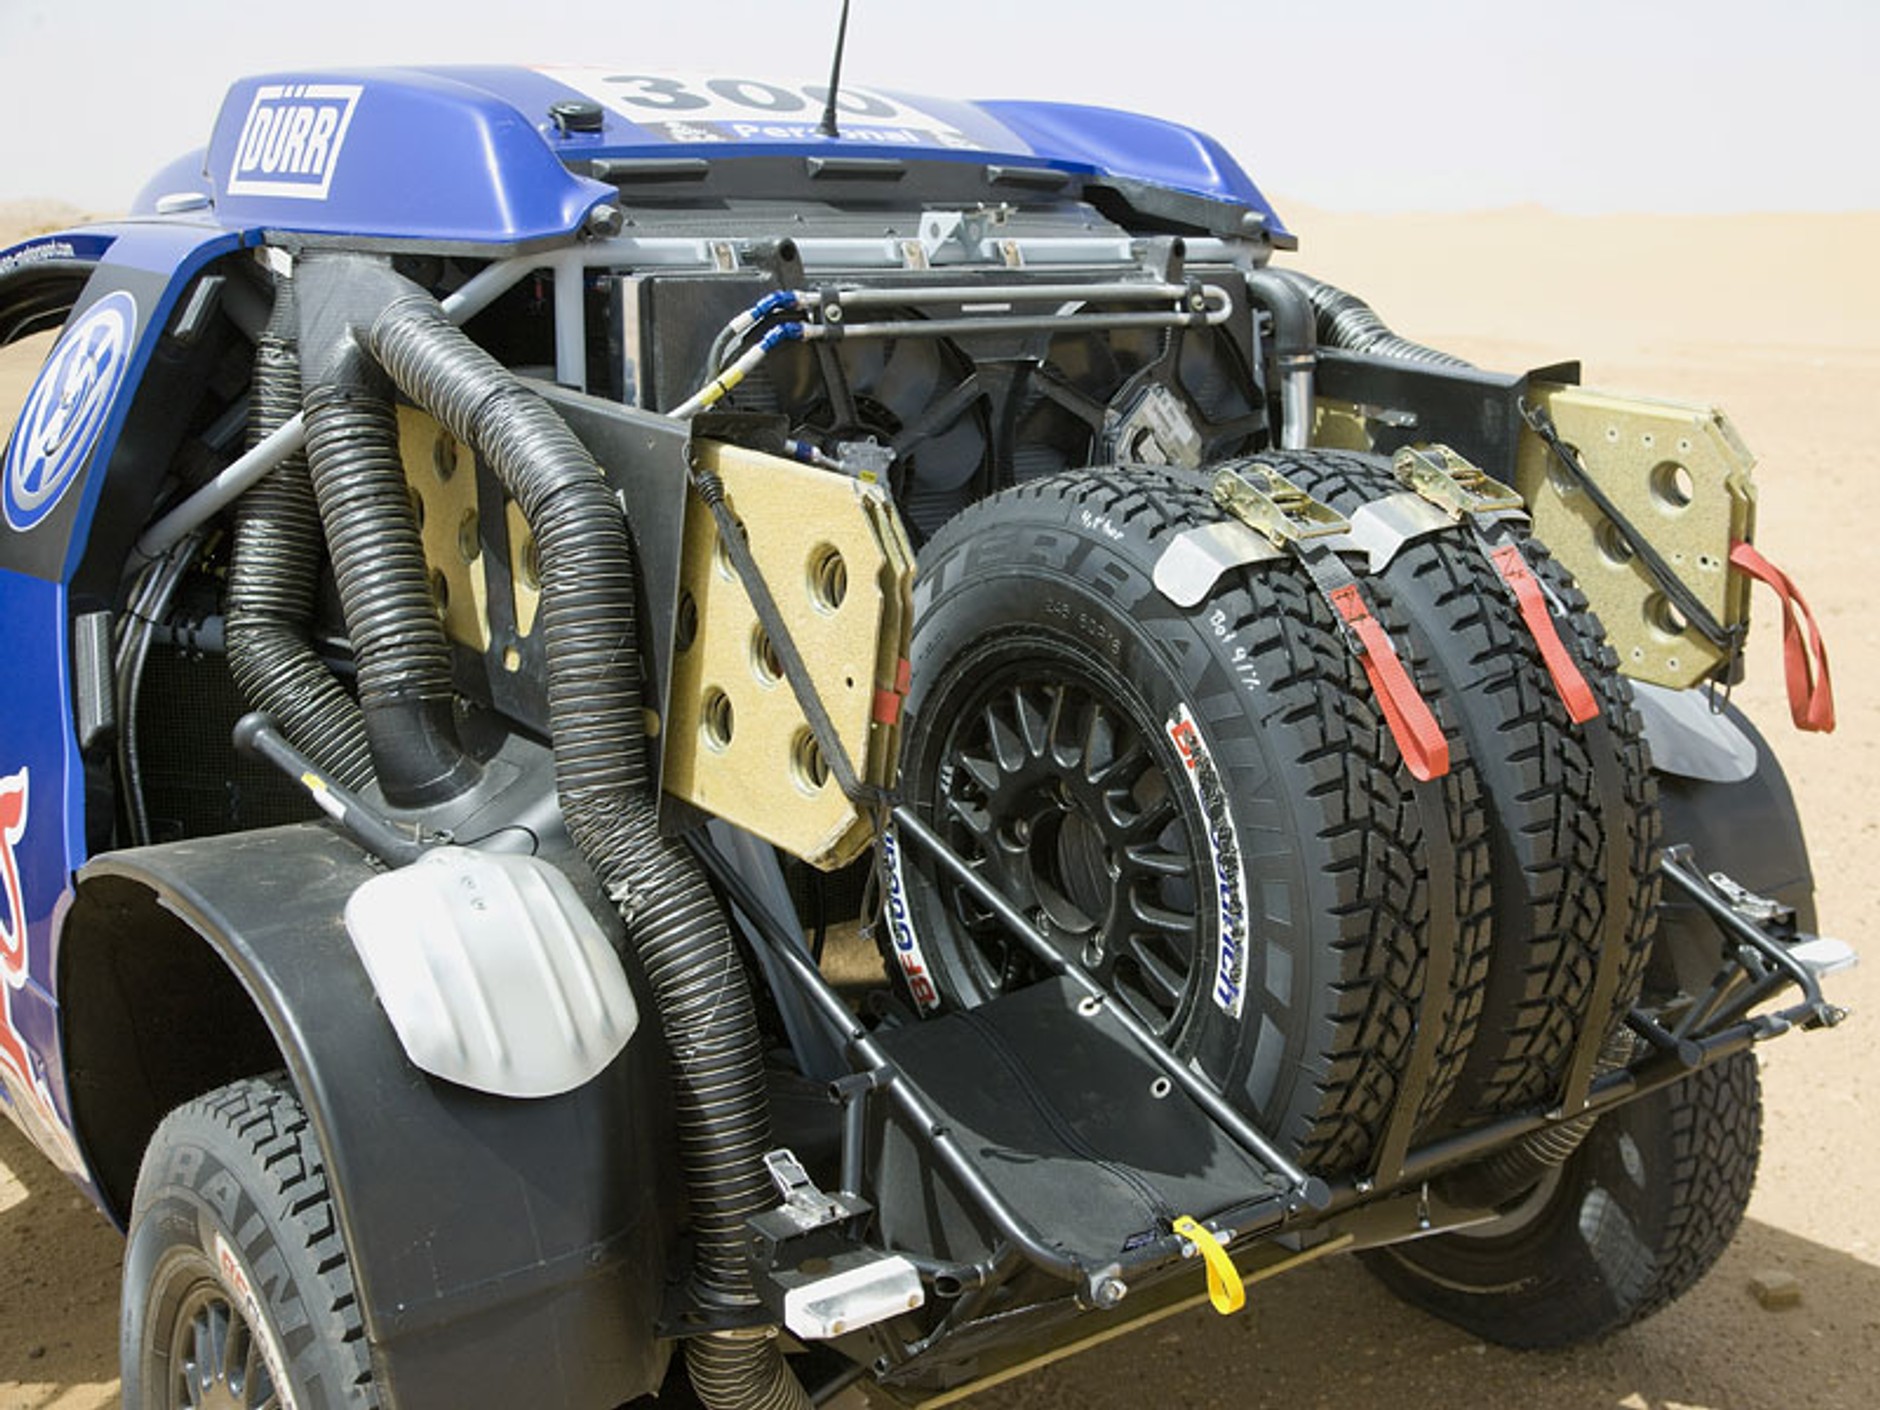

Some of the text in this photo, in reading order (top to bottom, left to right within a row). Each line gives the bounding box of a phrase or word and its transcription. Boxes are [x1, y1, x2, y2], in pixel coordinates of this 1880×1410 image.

[602, 74, 898, 118] 300
[240, 85, 340, 174] DÜRR
[733, 123, 921, 143] Pernal
